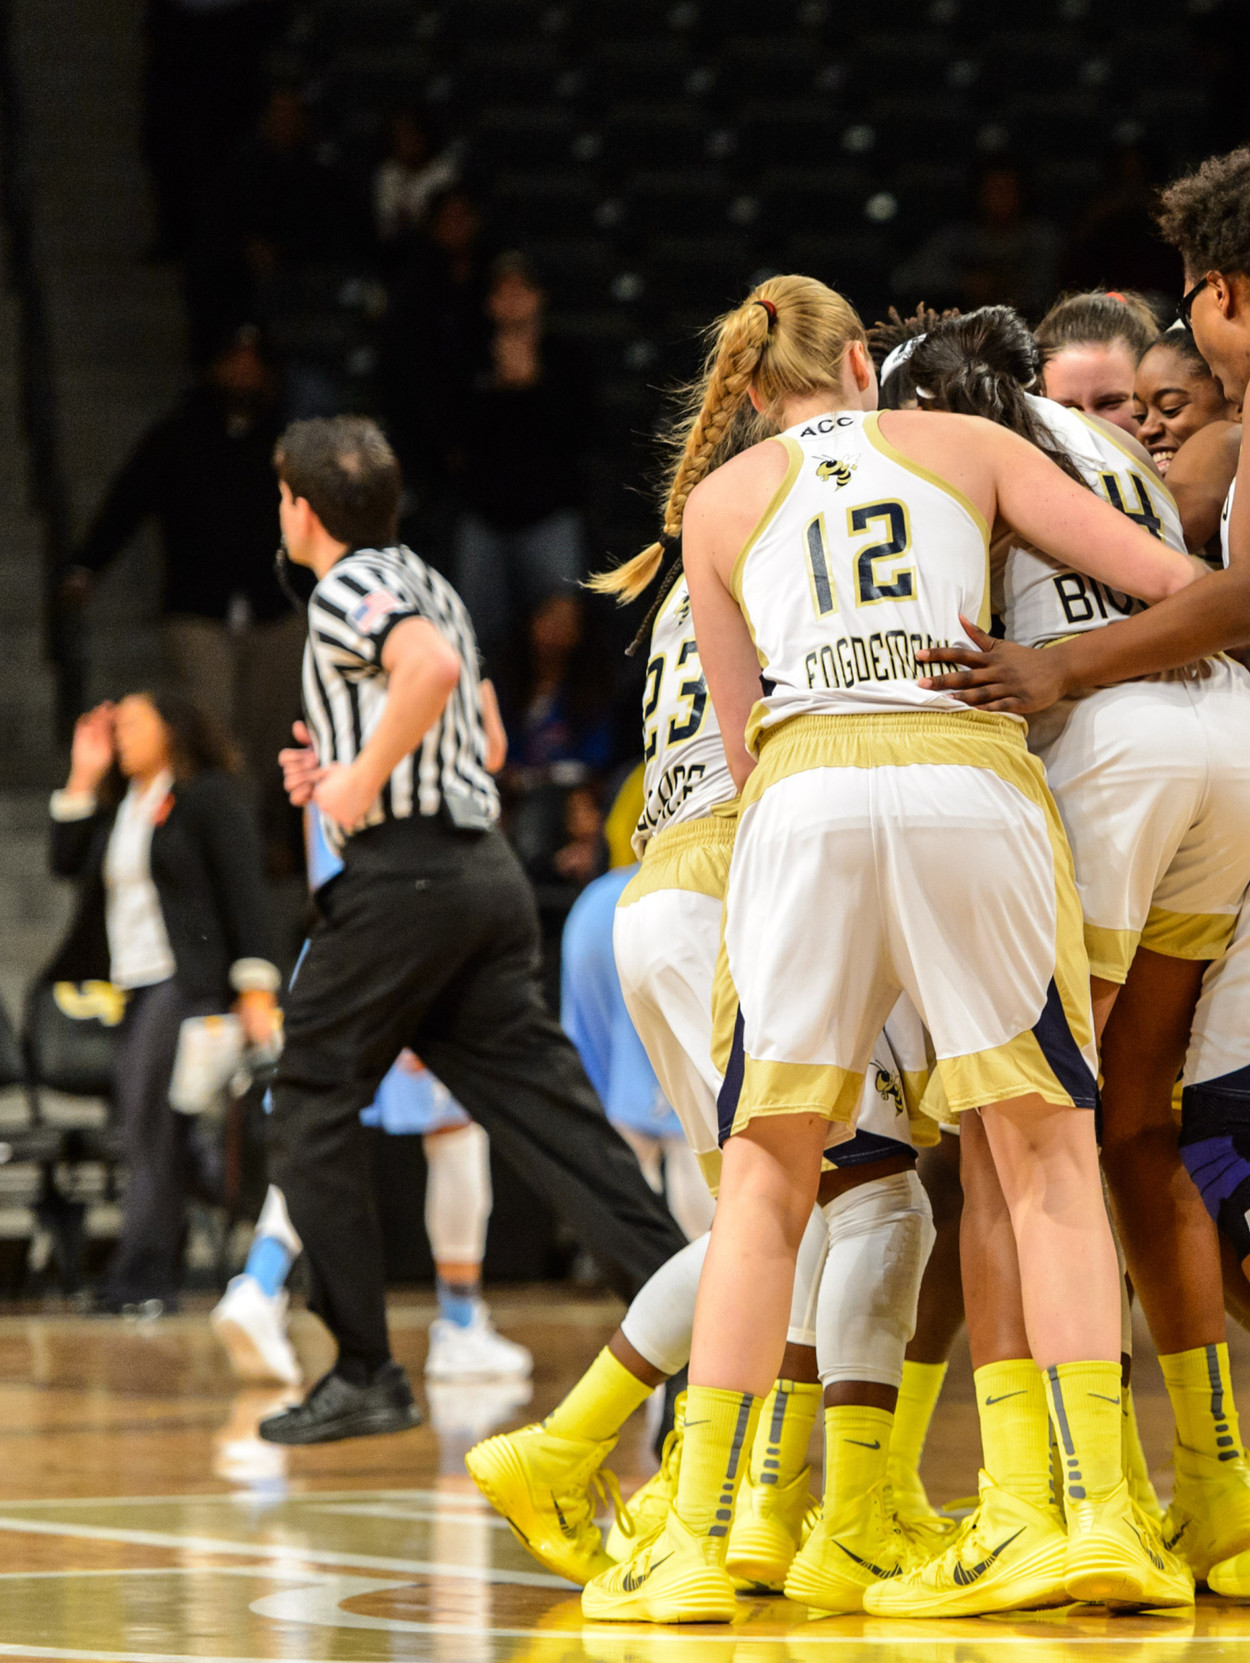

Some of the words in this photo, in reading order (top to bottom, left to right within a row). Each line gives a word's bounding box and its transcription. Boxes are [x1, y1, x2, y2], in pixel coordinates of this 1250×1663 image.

[800, 416, 854, 438] ACC
[802, 497, 917, 622] 12
[643, 637, 711, 765] 23
